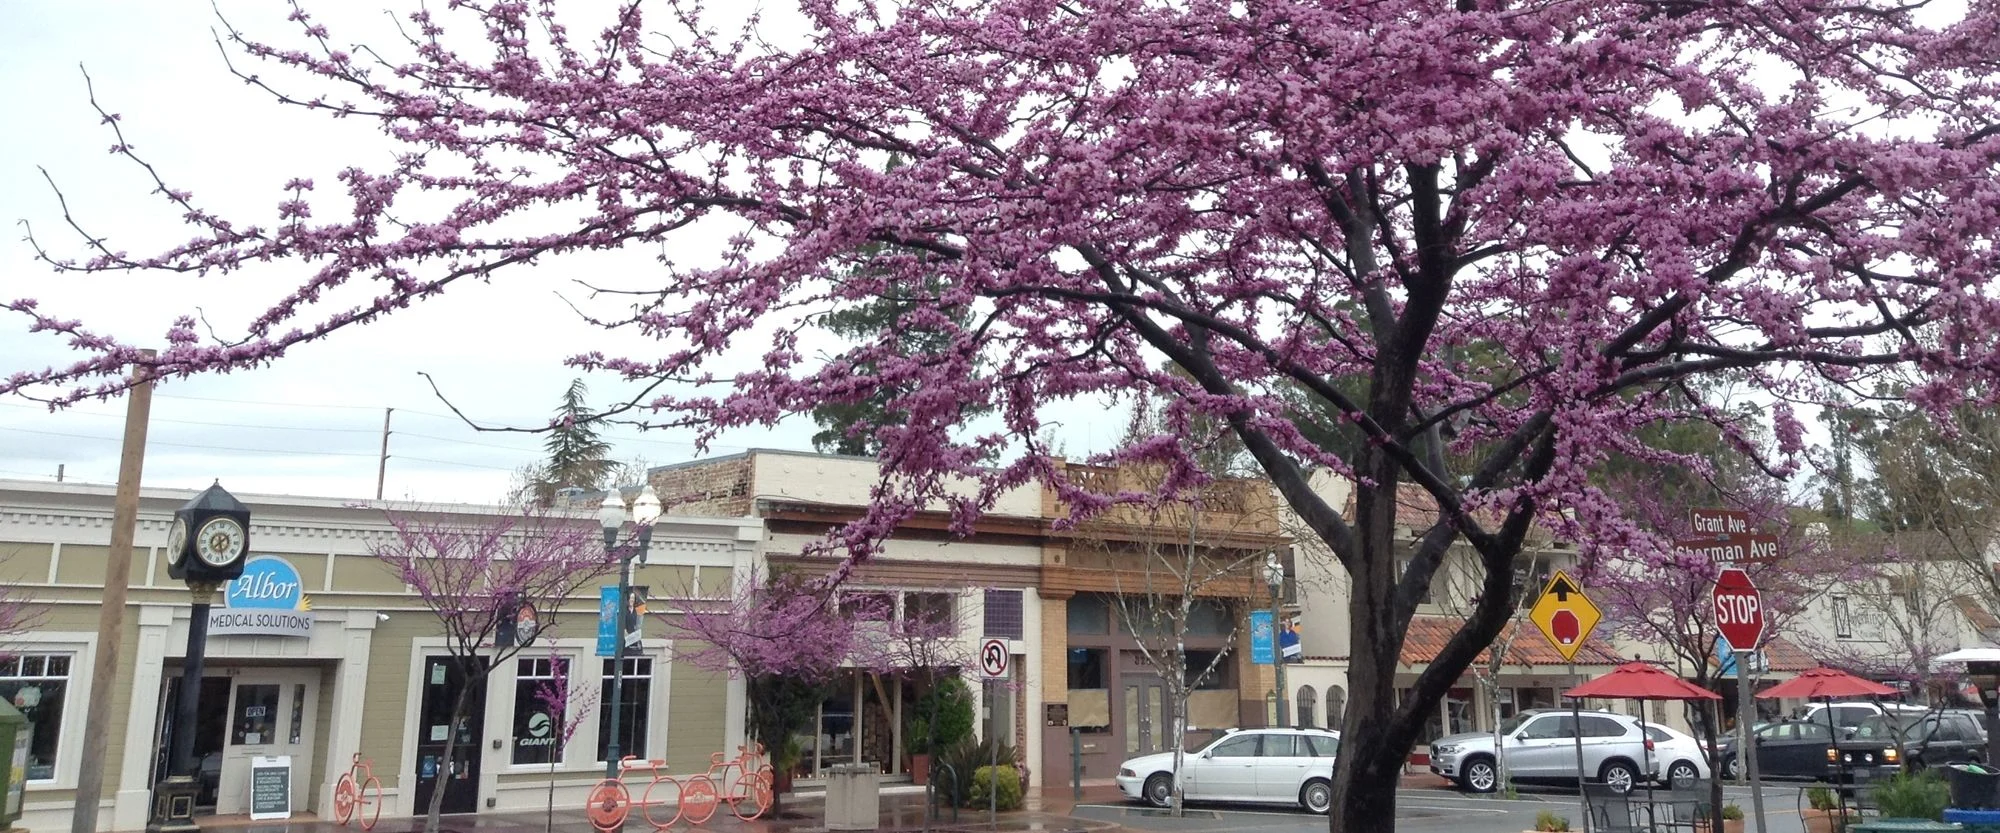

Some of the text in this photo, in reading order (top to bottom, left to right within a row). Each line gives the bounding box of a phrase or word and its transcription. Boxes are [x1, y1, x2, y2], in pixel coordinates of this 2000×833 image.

[1694, 513, 1746, 533] Grant Ave
[1750, 539, 1777, 559] Ave
[231, 571, 298, 599] Albor
[1717, 594, 1758, 624] STOP
[210, 614, 310, 630] MEDICAL SOLUTIONS
[520, 737, 556, 747] GIANT
